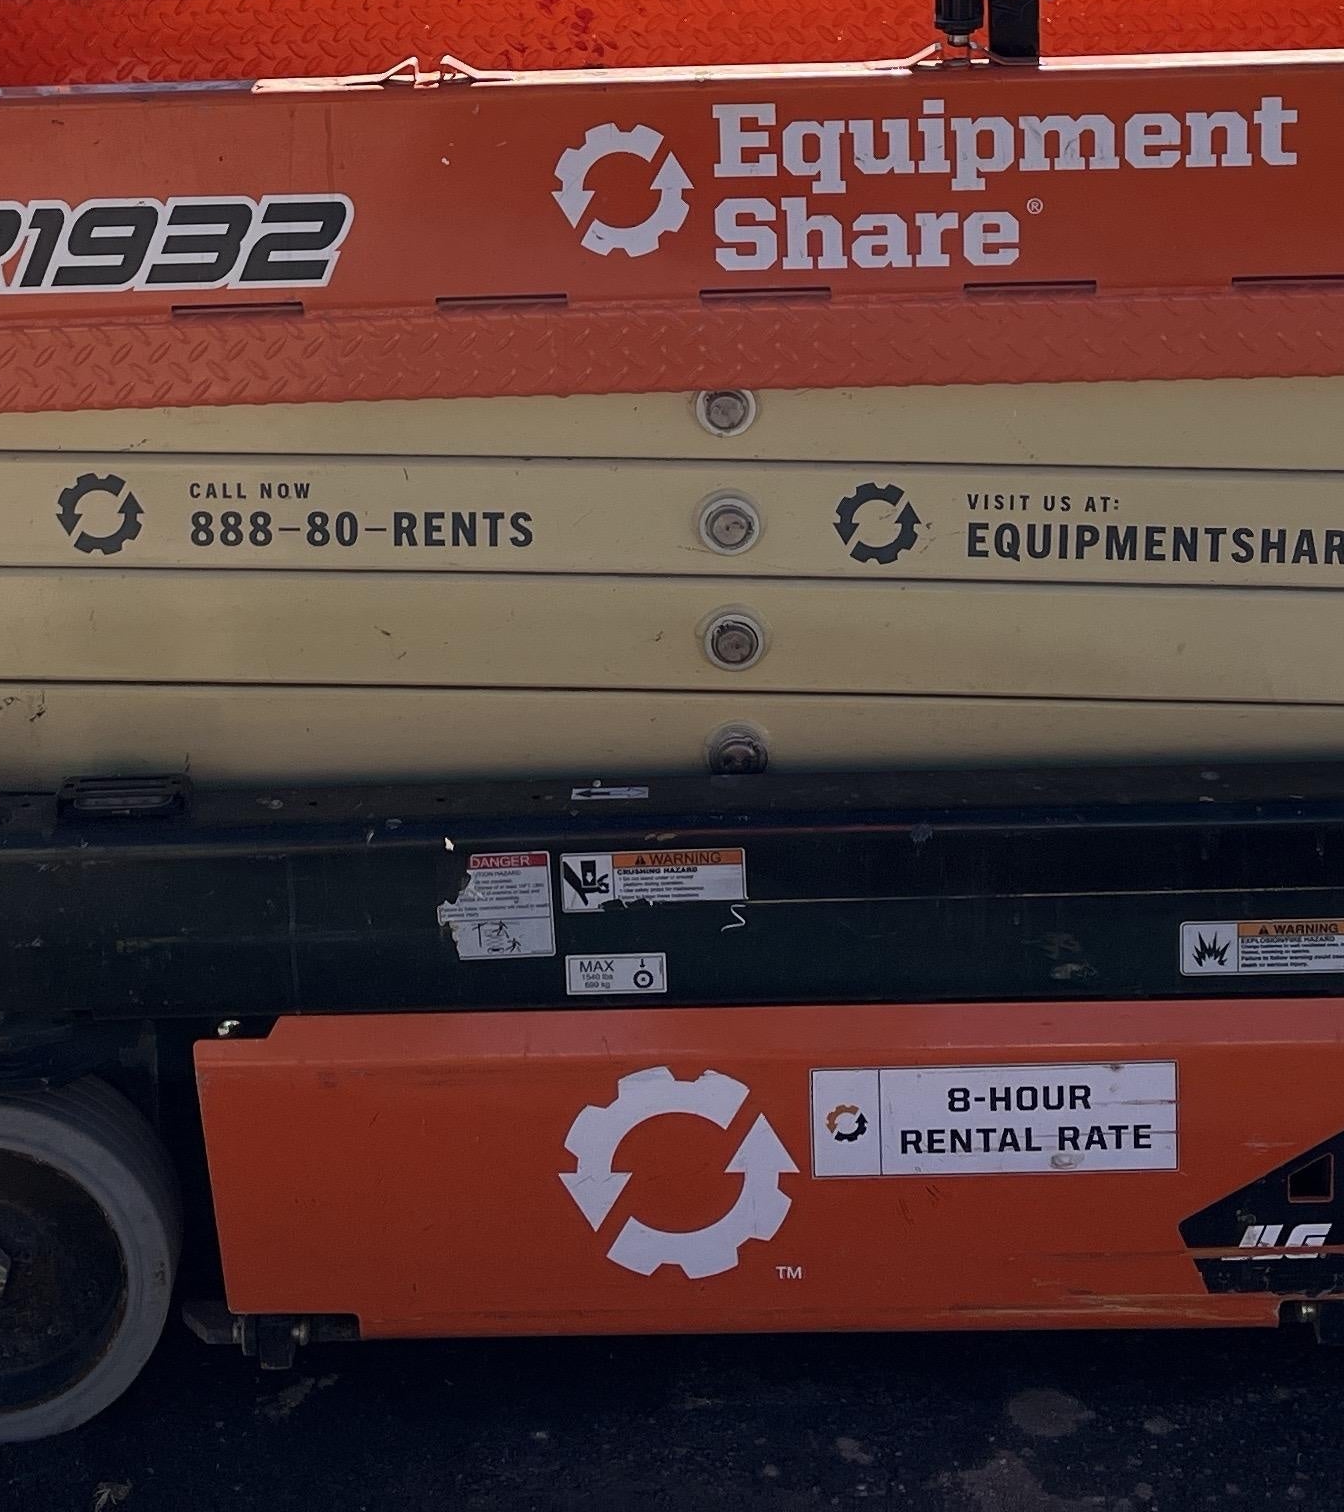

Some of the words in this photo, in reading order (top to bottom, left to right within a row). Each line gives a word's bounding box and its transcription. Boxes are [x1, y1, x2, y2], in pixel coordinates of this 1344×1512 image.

[711, 95, 1299, 194] Equipment
[713, 196, 1020, 272] Share
[188, 482, 248, 500] CALL
[259, 482, 312, 500] NOW
[966, 492, 1031, 512] VISIT
[1042, 494, 1073, 513] US
[1084, 495, 1120, 513] AT:
[189, 510, 534, 548] 888-80-RENTS
[470, 855, 531, 869] DANGER
[650, 851, 722, 865] WARNING
[663, 866, 698, 874] HAZARD
[1274, 923, 1339, 935] WARNING
[579, 959, 615, 973] MAX
[946, 1084, 1092, 1113] 8-HOUR
[900, 1126, 1043, 1155] RENTAL
[1058, 1124, 1153, 1152] RATE
[775, 1265, 803, 1280] TM
